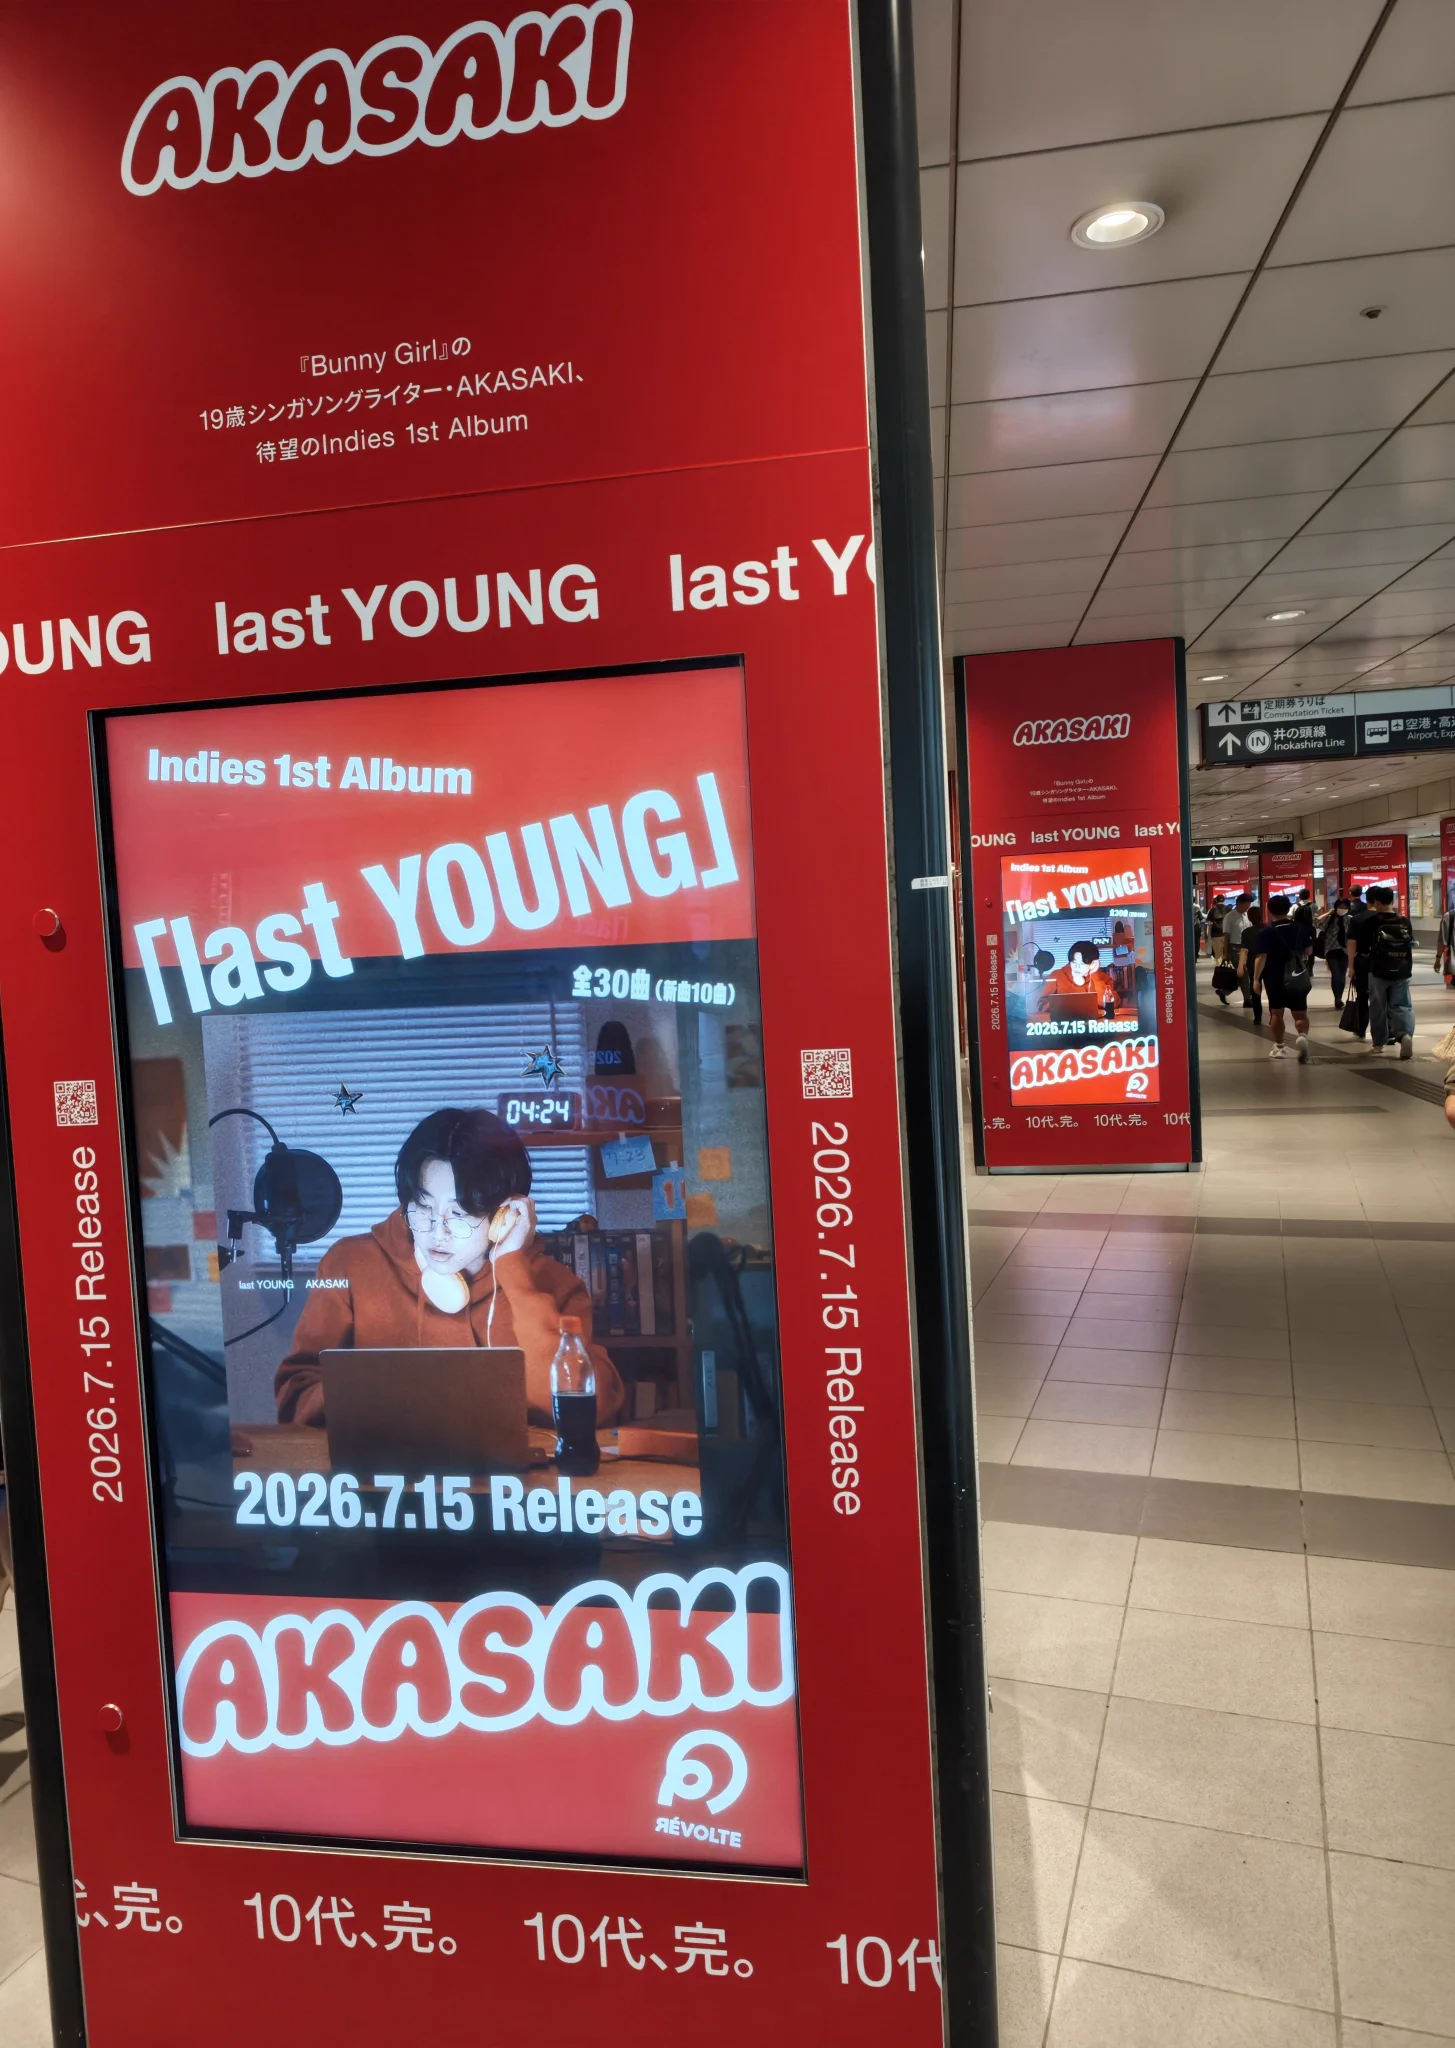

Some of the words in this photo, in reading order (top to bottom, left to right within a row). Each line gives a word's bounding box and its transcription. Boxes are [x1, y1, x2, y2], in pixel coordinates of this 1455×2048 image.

[121, 0, 633, 196] AKASAKI
[256, 427, 396, 464] 待望のIndies
[405, 421, 440, 445] 1st
[448, 413, 529, 440] Album
[0, 609, 152, 675] UNG
[214, 594, 332, 656] last
[341, 563, 600, 642] YOUNG
[669, 546, 800, 612] last
[811, 534, 877, 597] Y
[1263, 696, 1326, 710] 定期券うりば
[1264, 709, 1319, 719] Commutation
[1320, 707, 1345, 715] Ticket
[1013, 713, 1131, 746] AKASAKI
[1273, 725, 1327, 740] 井の頭線
[1274, 738, 1323, 751] Inokashira
[1325, 738, 1346, 748] Line
[147, 748, 267, 787] Indies
[273, 754, 331, 789] 1st
[339, 755, 473, 797] Album
[1031, 830, 1059, 844] last
[1061, 825, 1121, 841] YOUNG
[1134, 823, 1164, 837] last
[1166, 822, 1181, 836] Y
[1010, 862, 1041, 873] Indies
[1041, 863, 1056, 873] 1st
[1057, 864, 1089, 875] Album
[1026, 1019, 1086, 1036] 2026.7.15
[1088, 1018, 1139, 1034] Release
[1010, 1034, 1160, 1091] AKASAKI
[506, 1099, 569, 1124] 04:24
[72, 1145, 107, 1302] Release
[810, 1121, 860, 1331] 2026.7.15
[238, 1280, 255, 1290] last
[256, 1279, 295, 1290] YOUNG
[304, 1278, 349, 1289] AKASAKI
[79, 1316, 124, 1503] 2026.7.15
[823, 1346, 866, 1516] Release
[233, 1470, 476, 1532] 2026.7.15
[490, 1473, 704, 1538] Release
[173, 1560, 797, 1759] AKASAKI
